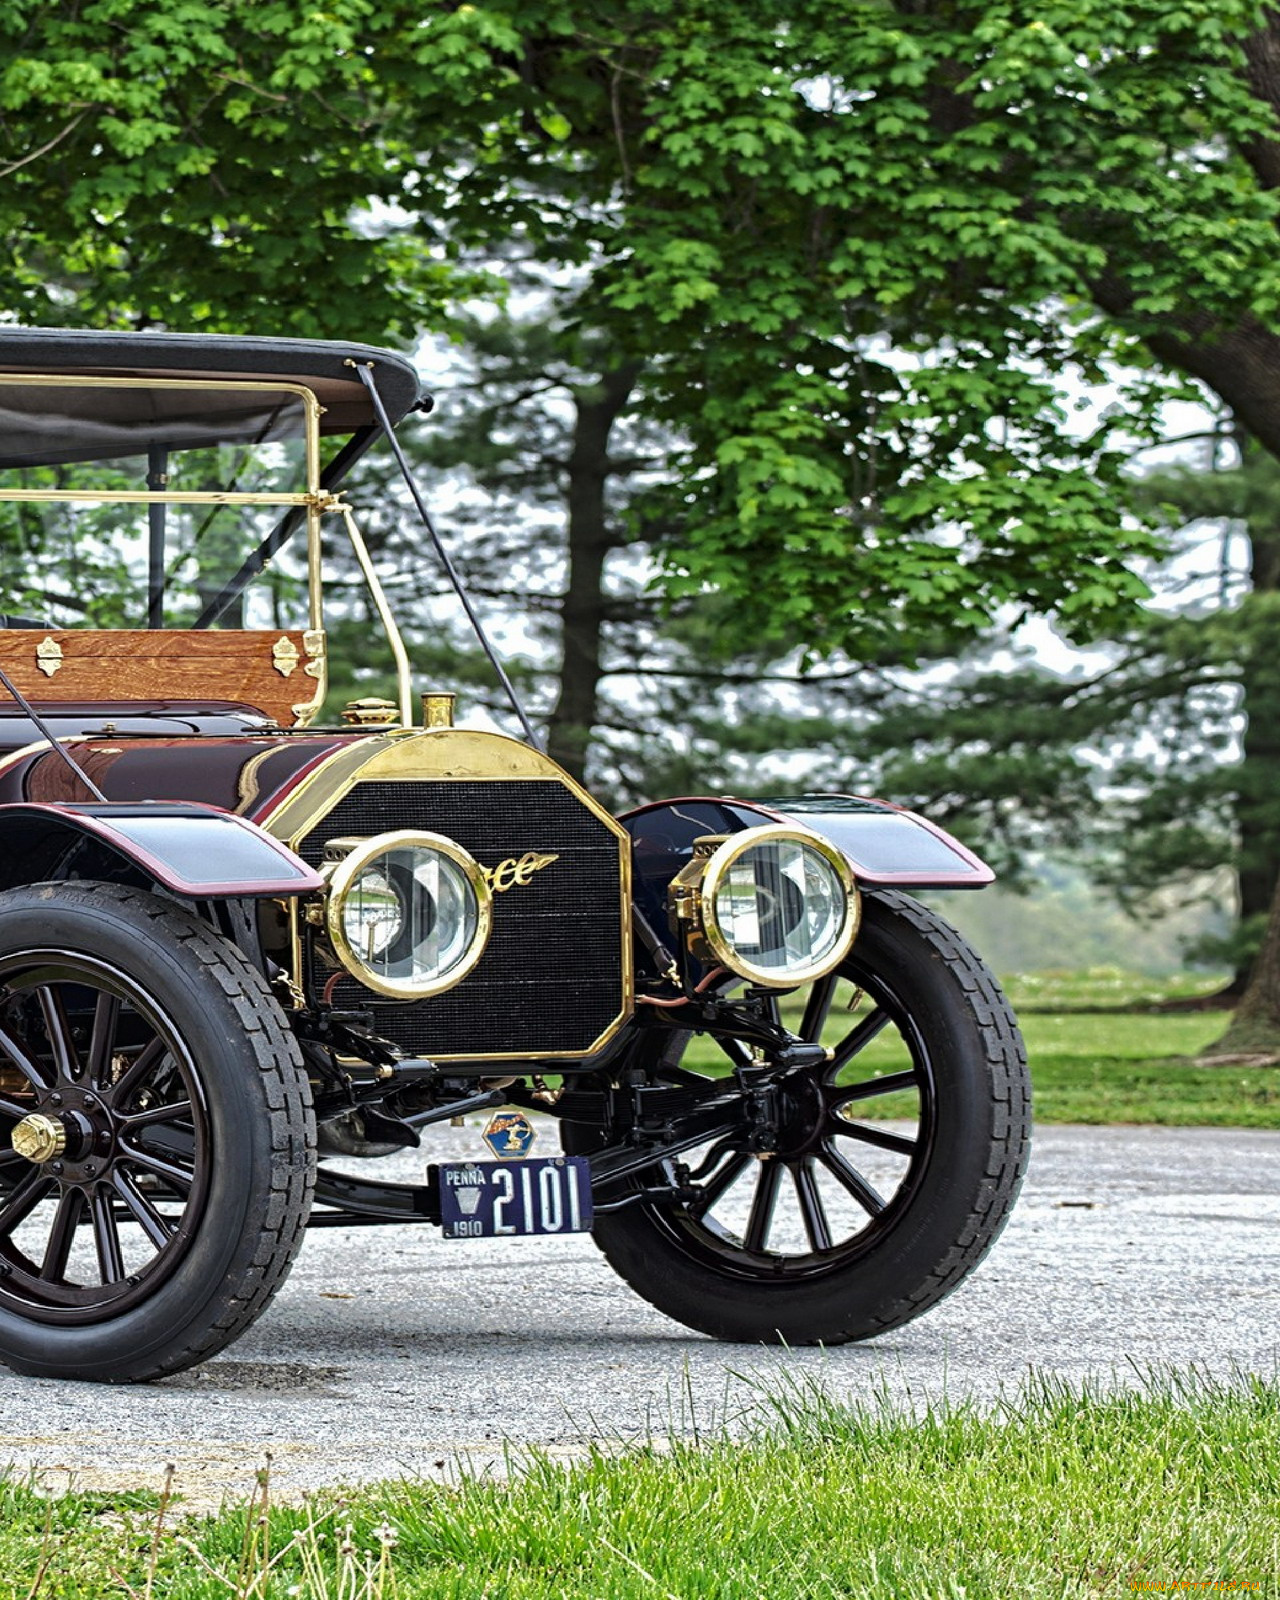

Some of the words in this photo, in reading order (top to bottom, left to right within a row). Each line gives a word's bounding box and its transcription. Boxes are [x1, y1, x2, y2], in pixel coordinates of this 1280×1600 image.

[446, 1168, 486, 1186] PENNA
[491, 1165, 581, 1234] 2101
[453, 1220, 483, 1237] 1910
